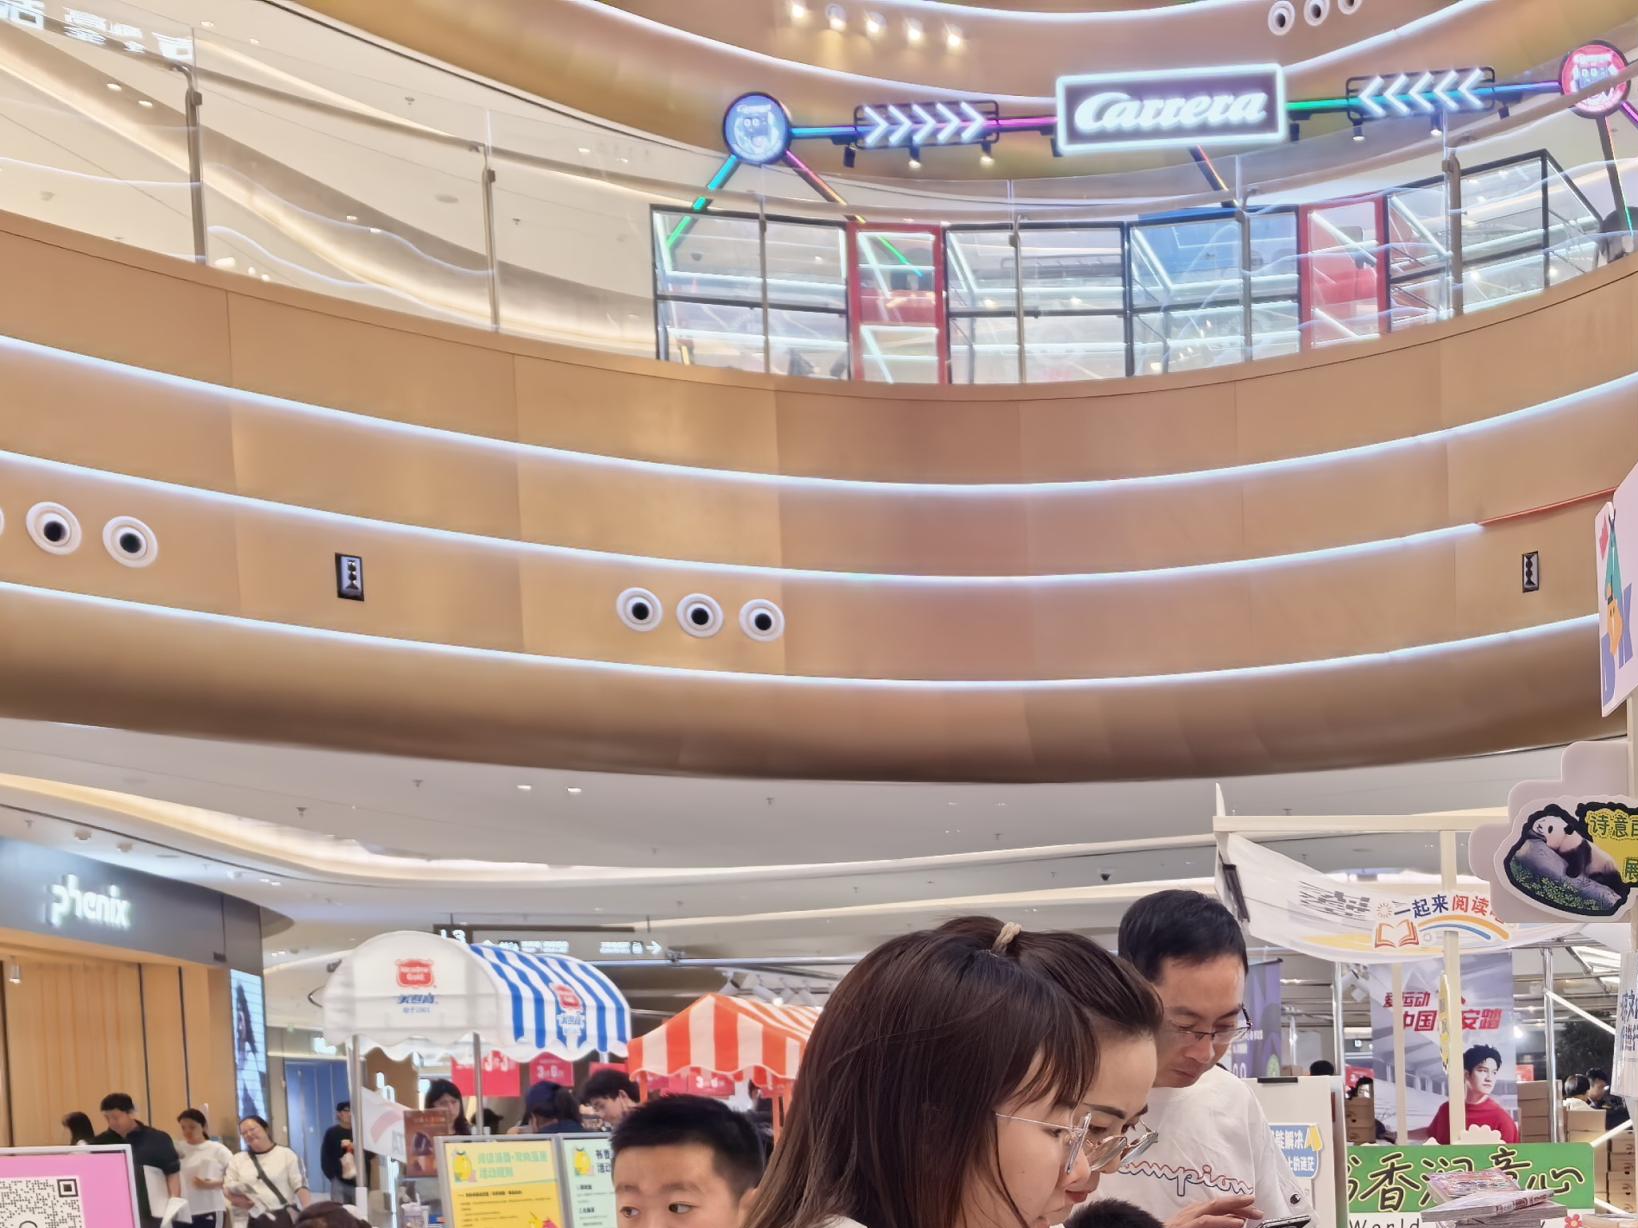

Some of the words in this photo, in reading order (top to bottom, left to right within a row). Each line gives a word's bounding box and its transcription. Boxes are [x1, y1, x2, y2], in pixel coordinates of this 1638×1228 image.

[1073, 84, 1270, 136] Carrera
[51, 874, 131, 930] phenix
[1402, 1008, 1503, 1032] 中国安踏
[1348, 1146, 1585, 1212] 香润童心
